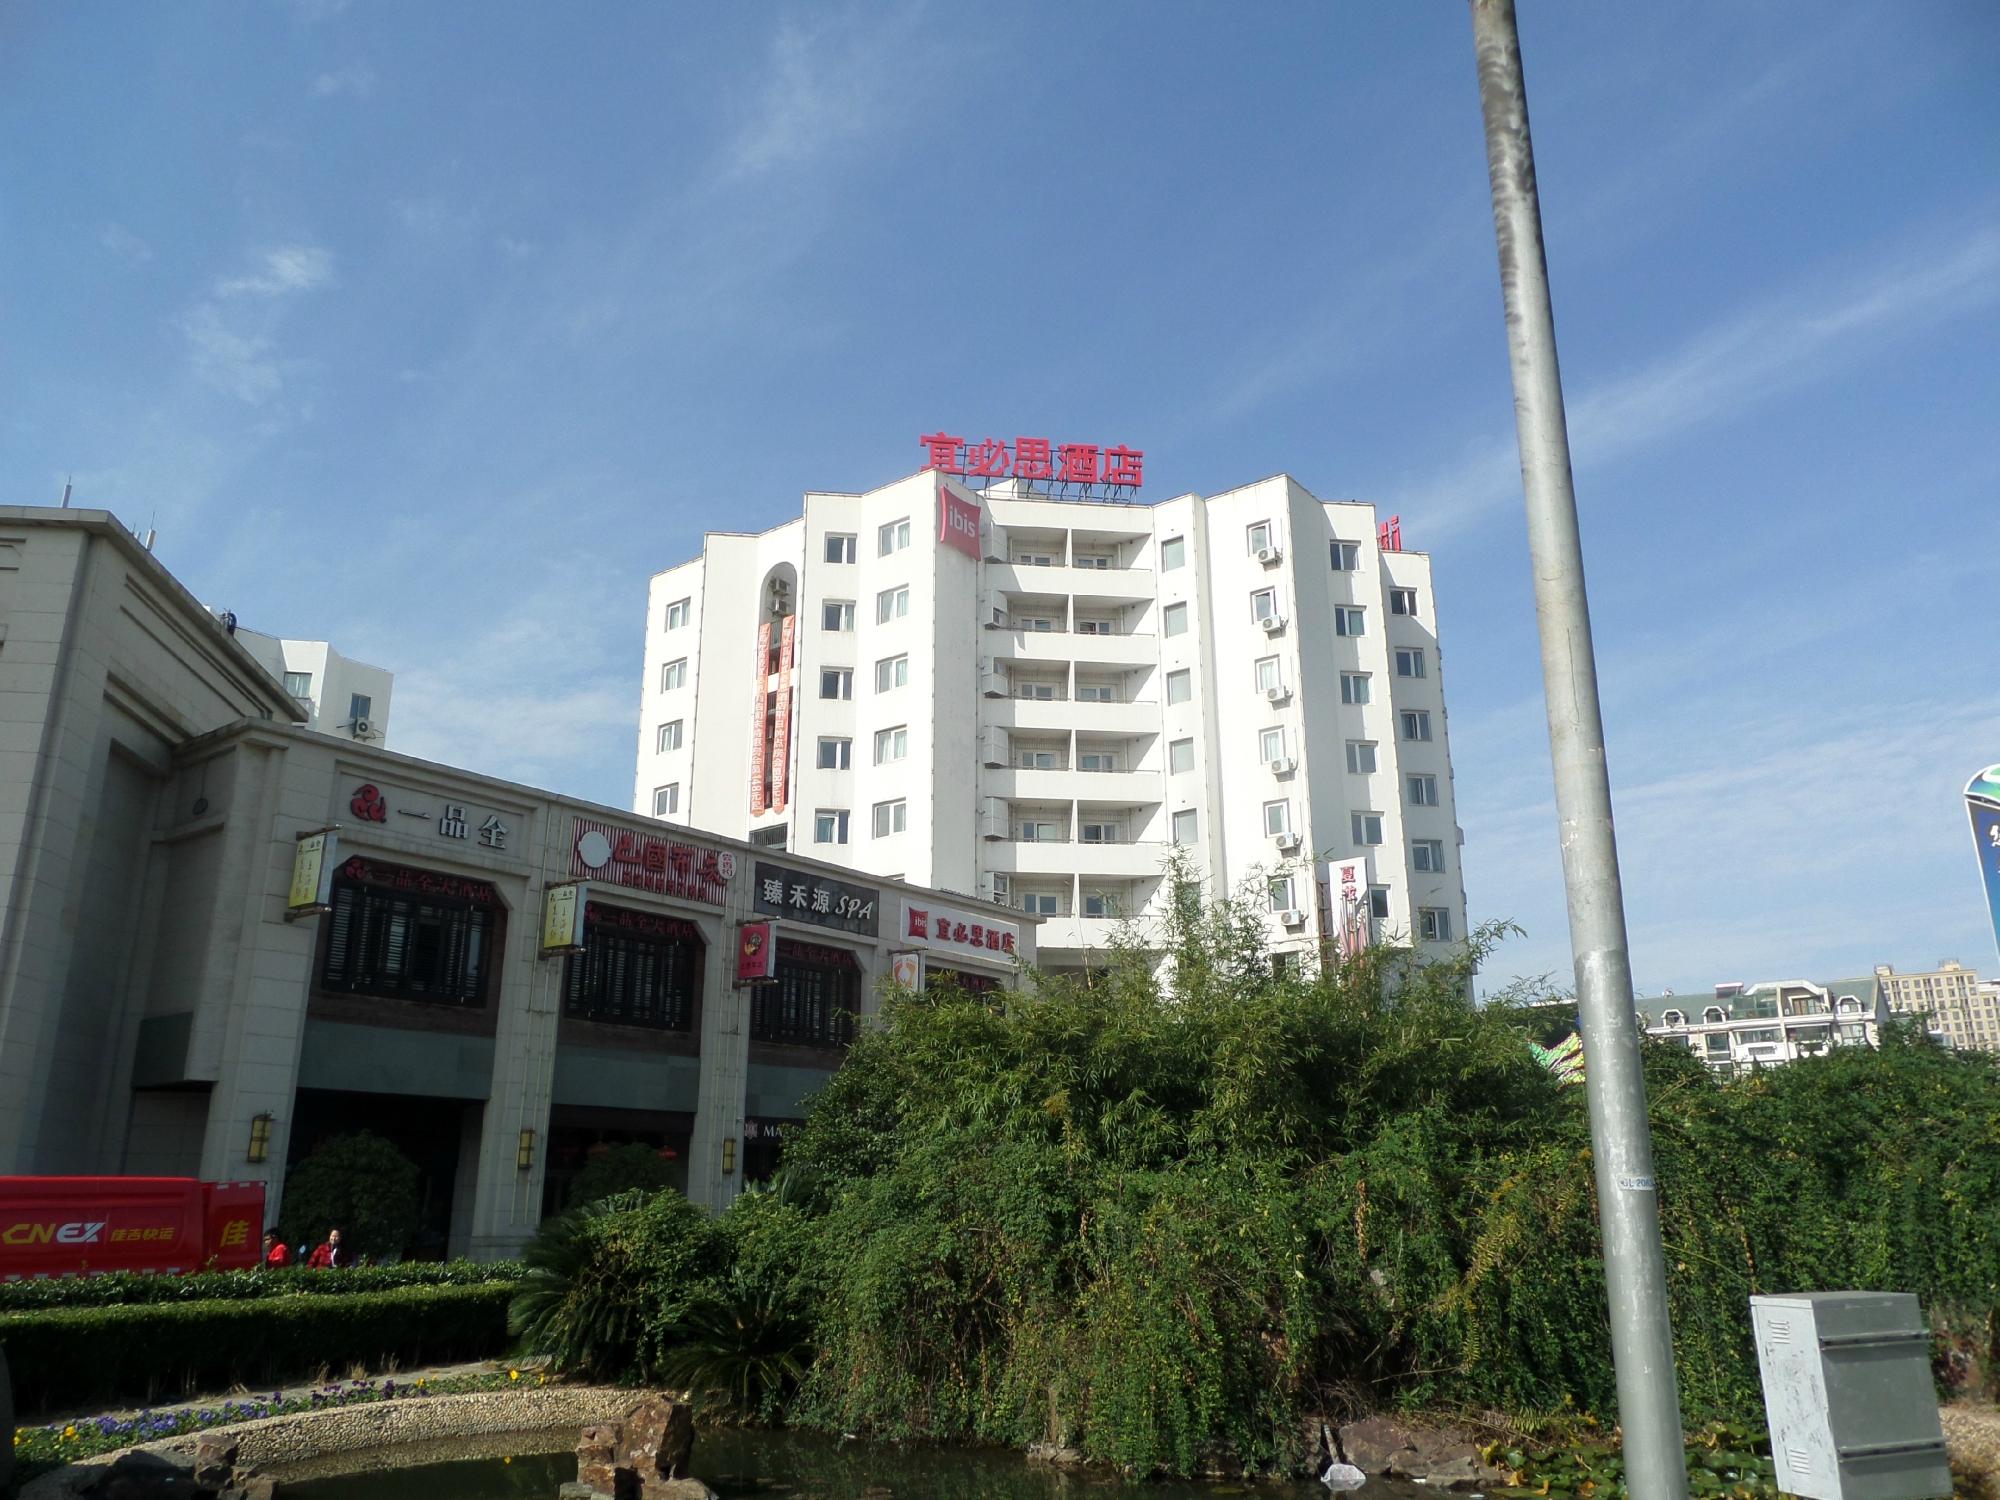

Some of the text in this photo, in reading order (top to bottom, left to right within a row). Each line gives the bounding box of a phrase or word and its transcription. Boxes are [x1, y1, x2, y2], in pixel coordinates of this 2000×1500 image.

[920, 432, 1144, 487] 宜必思酒店
[949, 505, 977, 538] ibis
[398, 804, 509, 850] 一品全
[763, 879, 874, 921] 臻禾源 SPA
[936, 917, 1016, 953] 宜必思酒店
[2, 1222, 106, 1244] CNEX
[219, 1219, 250, 1248] 佳
